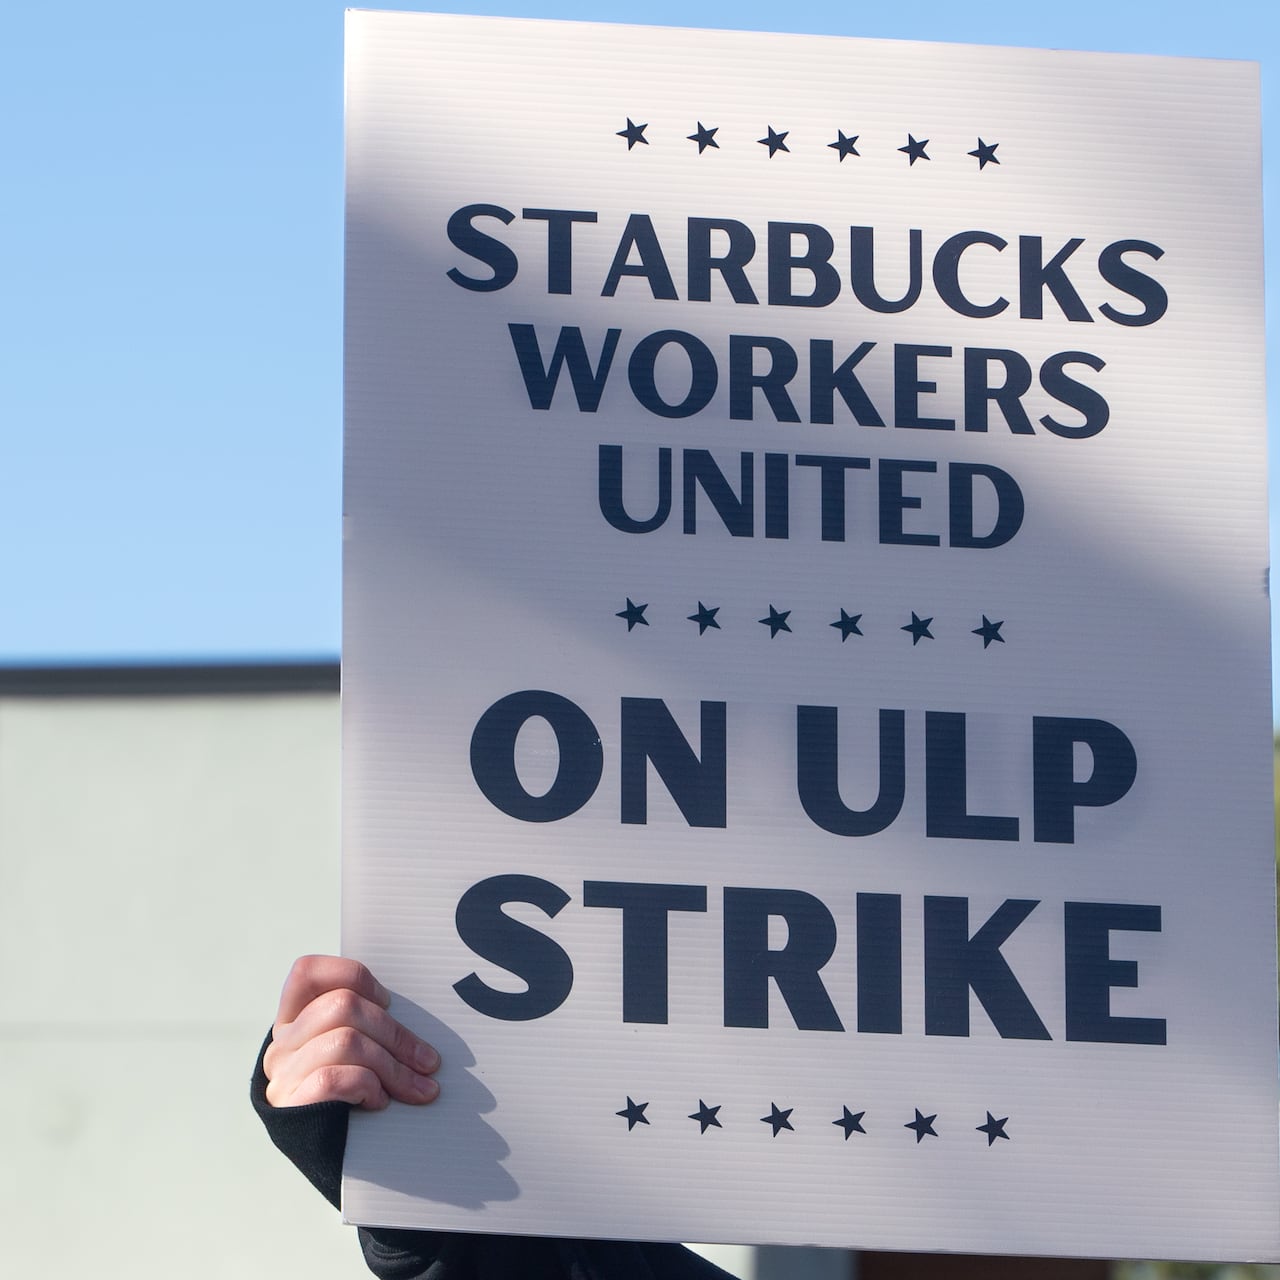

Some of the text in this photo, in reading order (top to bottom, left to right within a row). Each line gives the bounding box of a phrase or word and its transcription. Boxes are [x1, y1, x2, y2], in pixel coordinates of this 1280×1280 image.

[446, 203, 1168, 327] STARBUCKS
[506, 322, 1110, 440] WORKERS
[598, 443, 1025, 550] UNITED
[469, 689, 1138, 845] ON ULP
[451, 873, 1167, 1046] STRIKE
